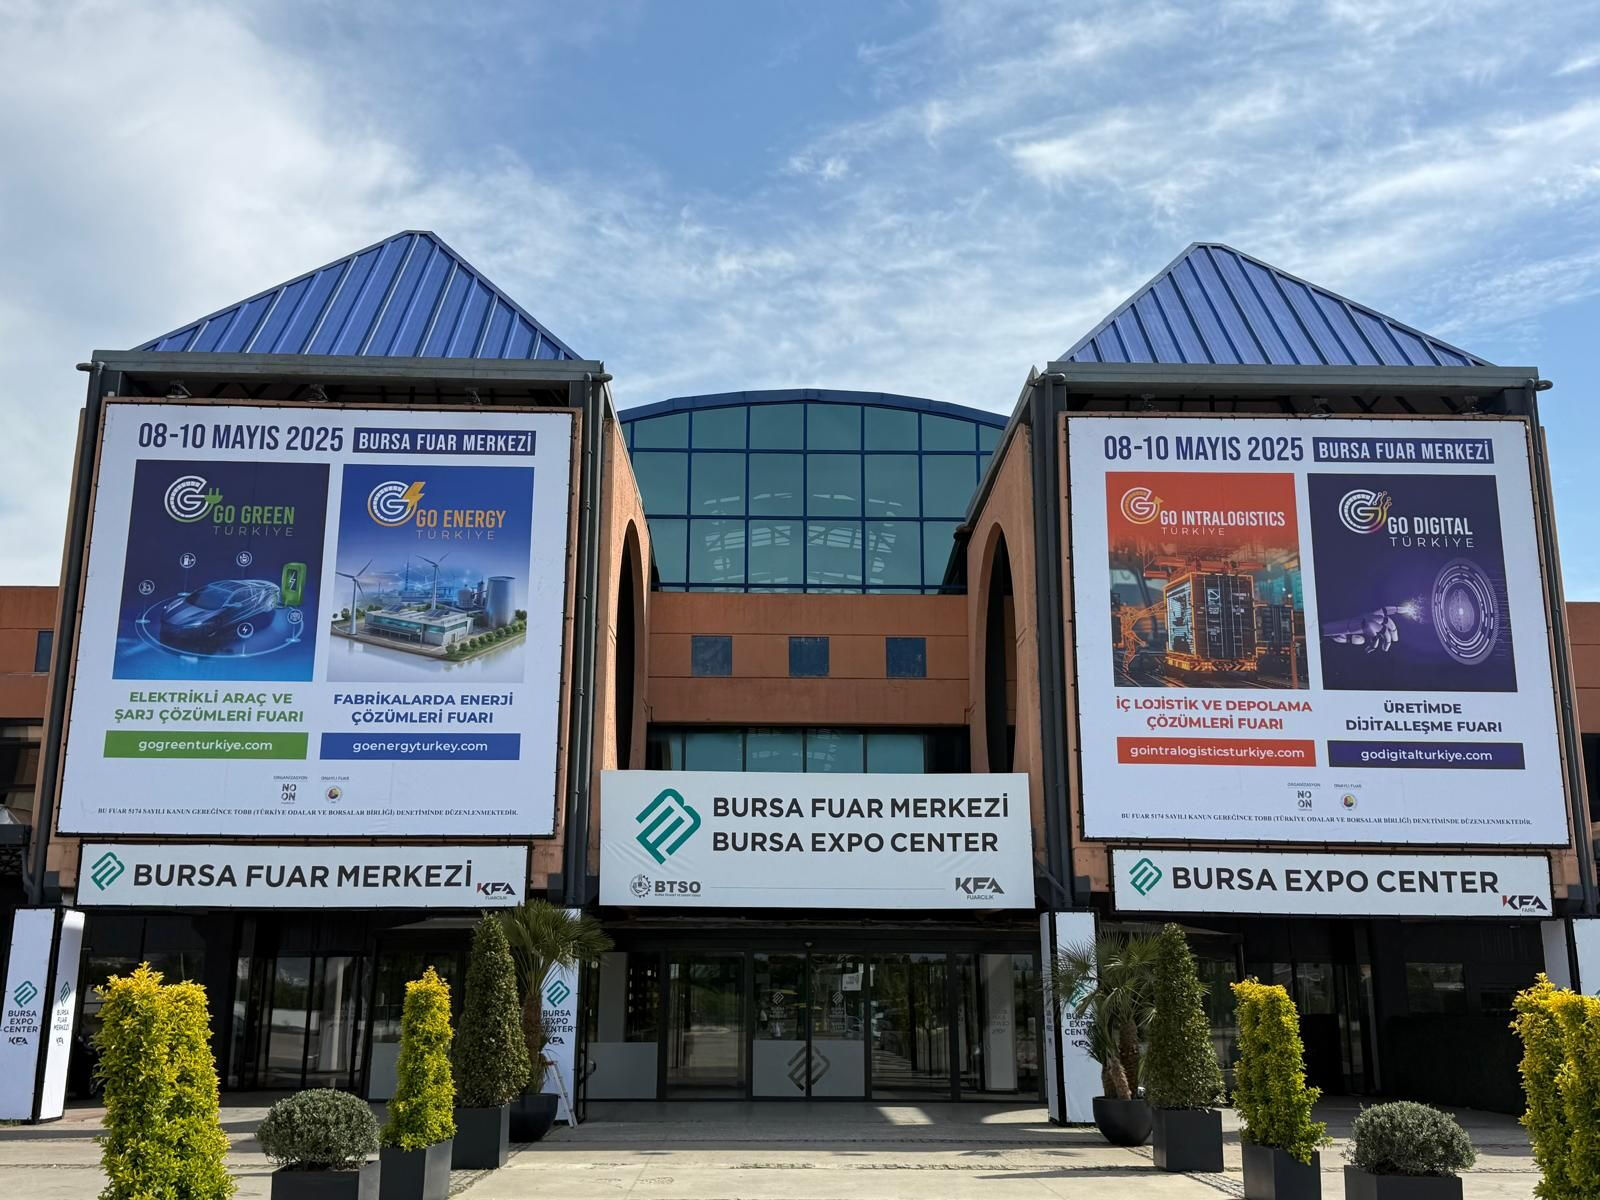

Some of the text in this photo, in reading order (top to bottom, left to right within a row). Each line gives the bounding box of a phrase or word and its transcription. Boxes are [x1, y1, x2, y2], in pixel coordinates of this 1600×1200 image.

[138, 423, 343, 452] 08-10 MAYIS 2025
[359, 432, 531, 452] BURSA FUAR MERKEZİ
[1104, 436, 1304, 461] 08-10 MAYIS 2025
[1319, 441, 1489, 460] BURSA FUAR MERKEZİ
[213, 505, 294, 524] GO GREEN
[416, 510, 506, 528] GO ENERGY
[1160, 510, 1285, 526] GO INTRALOGISTICS
[213, 524, 293, 537] TÜRKİYE
[416, 528, 494, 540] TÜRKİYE
[1161, 526, 1224, 535] TÜRKİYE
[1388, 517, 1472, 535] GO DIGITAL
[1390, 536, 1474, 548] TÜRKİYE
[130, 690, 292, 706] ELEKTRİKLİ ARAÇ VE
[334, 692, 513, 705] FABRİKALARDA ENERJİ
[1116, 696, 1312, 712] İÇ LOJİSTİK VE DEPOLAMA
[1384, 700, 1462, 714] ÜRETİMDE
[114, 707, 304, 724] ŞARJ ÇÖZÜMLERİ FUARI
[352, 709, 493, 725] ÇÖZÜMLERİ FUARI
[1147, 713, 1283, 730] ÇÖZÜMLERİ FUARI
[1346, 717, 1502, 734] DİJİTALLEŞME FUARI
[139, 740, 272, 752] gogreenturkiye.com
[353, 741, 487, 753] goenergyturkey.com
[1130, 745, 1304, 759] gointralogisticsturkiye.com
[1361, 749, 1492, 762] godigitalturkiye.com
[281, 792, 296, 800] ON
[1298, 800, 1312, 808] ON
[713, 793, 1008, 818] BURSA FUAR MERKEZİ
[713, 832, 998, 852] BURSA EXPO CENTER
[134, 860, 472, 888] BURSA FUAR MERKEZİ
[1172, 867, 1499, 893] BURSA EXPO CENTER
[477, 883, 516, 895] KFA
[655, 881, 701, 893] BTSO
[955, 877, 1005, 894] KFA
[1502, 896, 1548, 910] KFA
